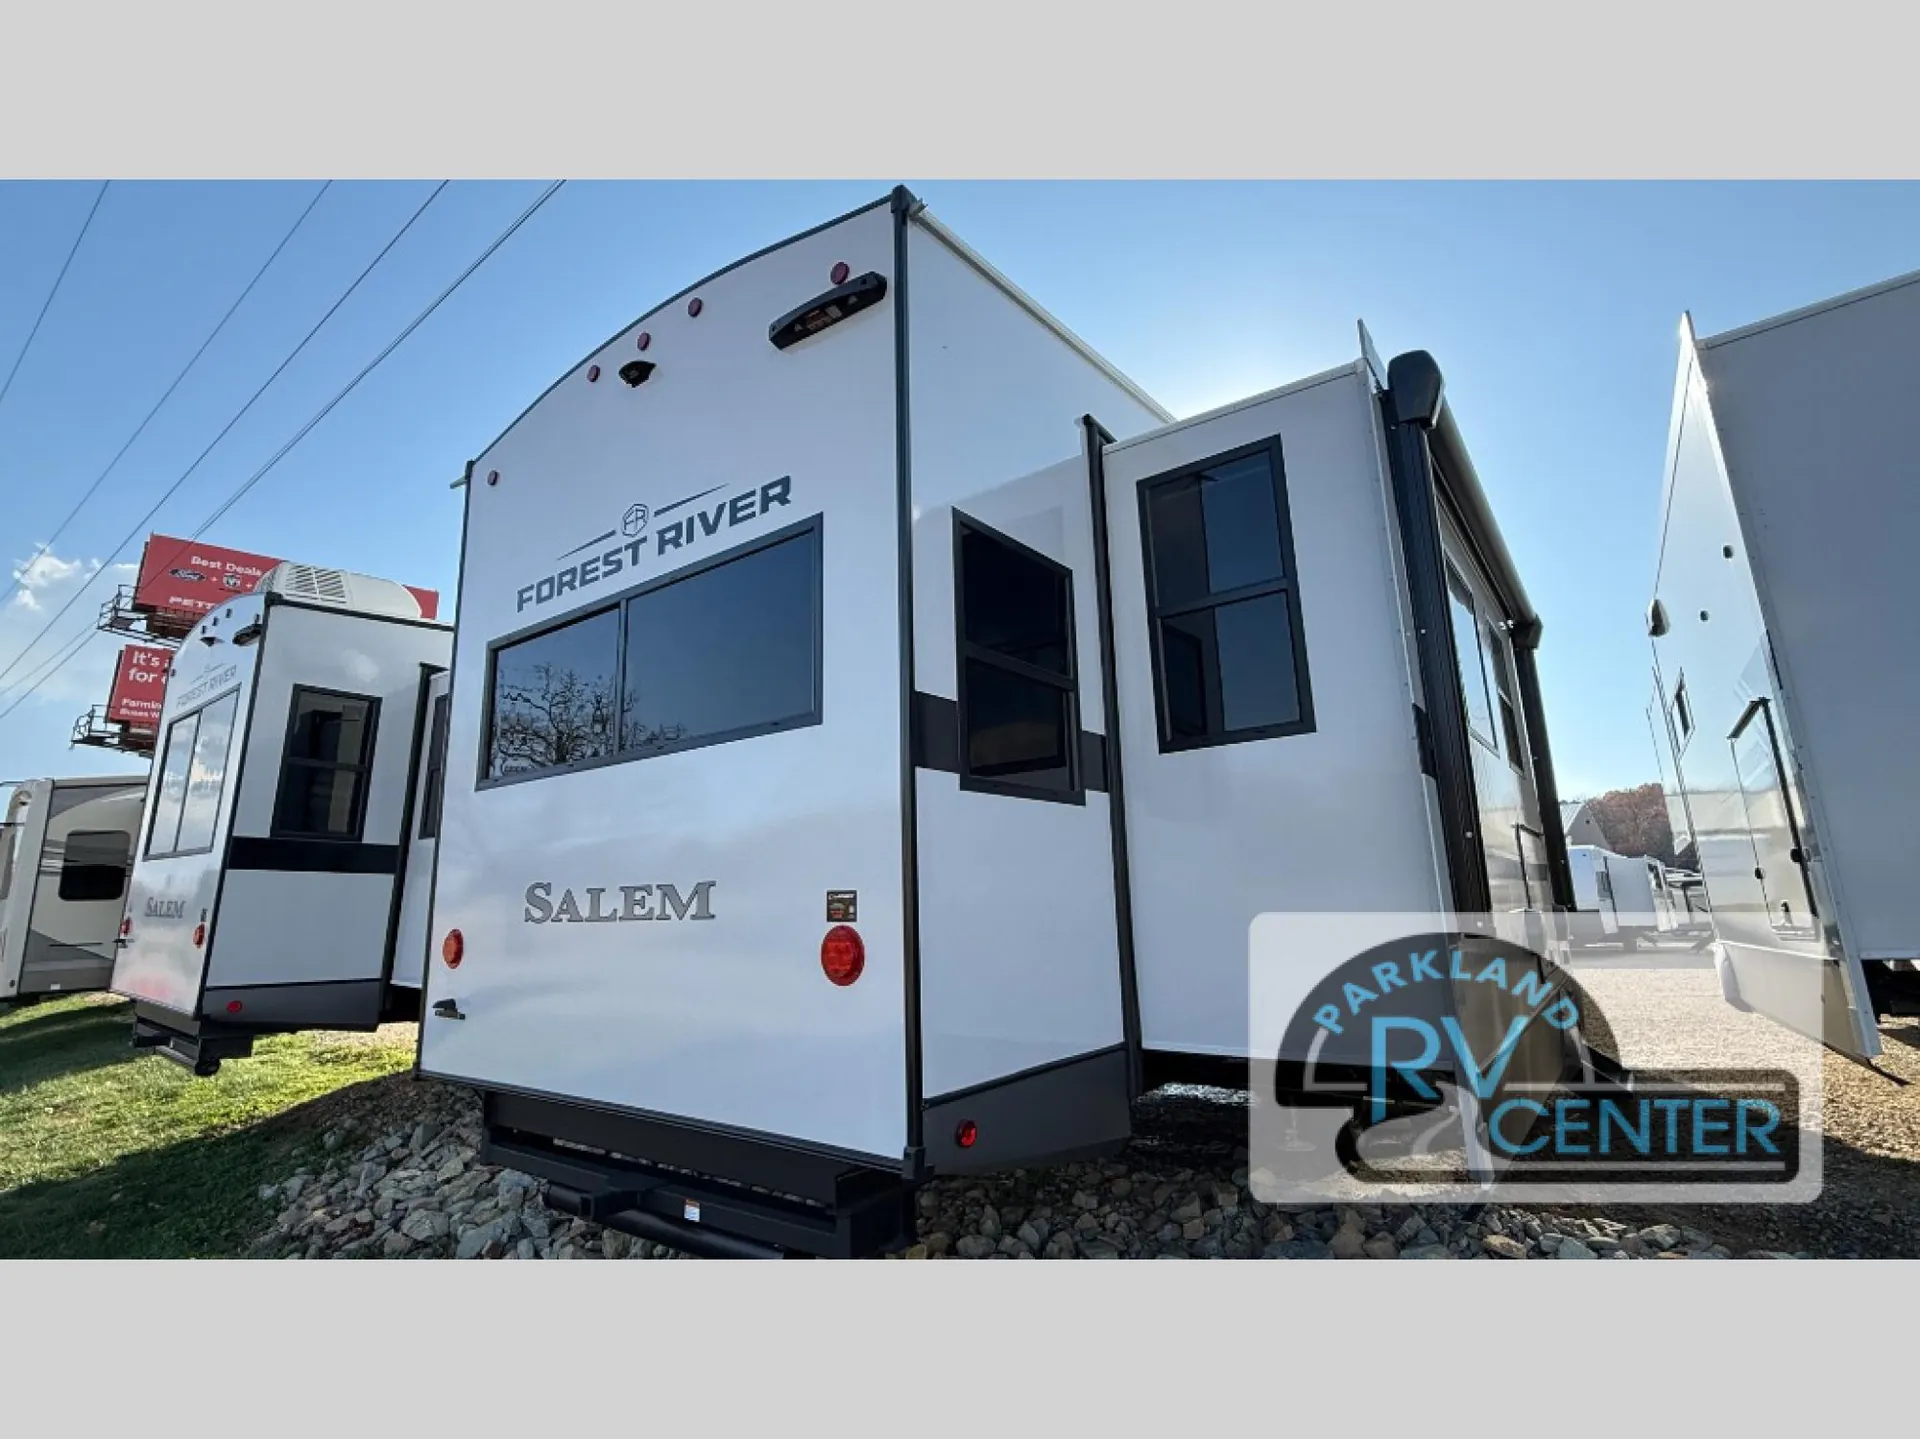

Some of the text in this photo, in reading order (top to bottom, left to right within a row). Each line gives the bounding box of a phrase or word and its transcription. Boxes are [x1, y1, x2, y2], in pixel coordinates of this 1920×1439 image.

[516, 475, 792, 613] FOREST RIVER
[190, 556, 262, 576] Best Deals
[132, 651, 160, 667] It's
[128, 667, 158, 683] for
